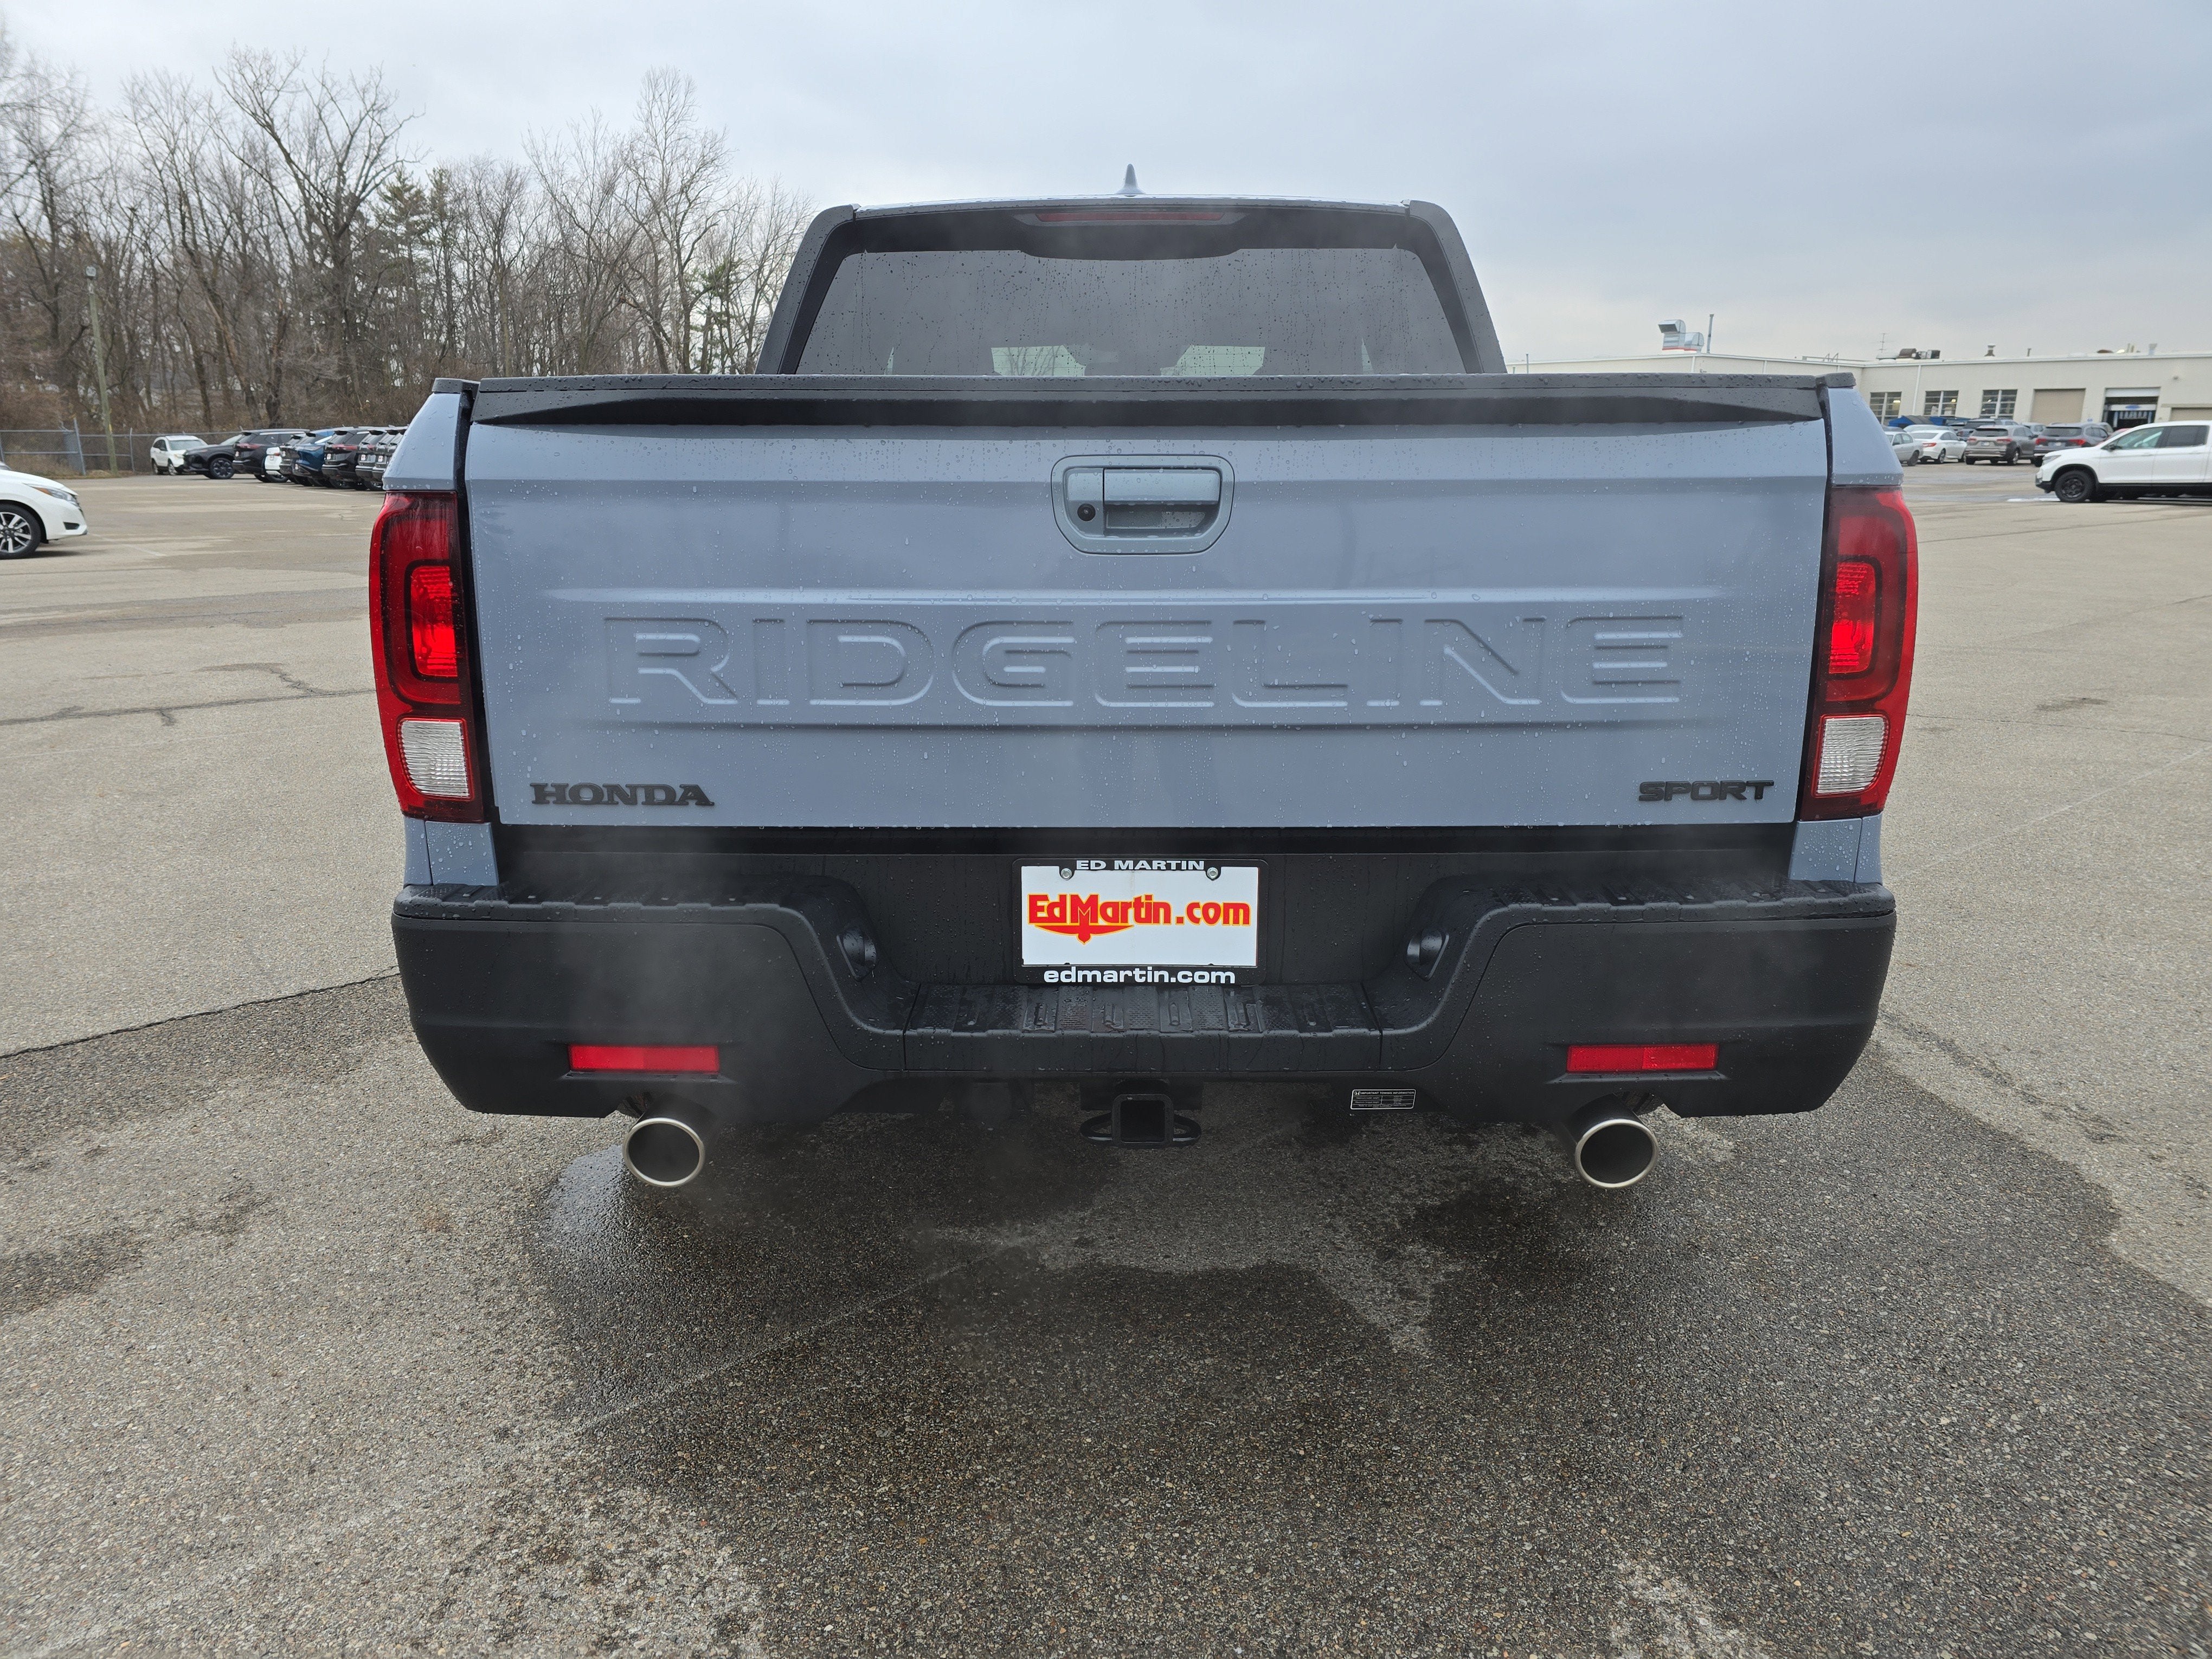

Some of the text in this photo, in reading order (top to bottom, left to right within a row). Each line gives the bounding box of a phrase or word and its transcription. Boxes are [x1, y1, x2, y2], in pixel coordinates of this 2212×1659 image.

[603, 617, 1684, 707] RIDGELINE
[530, 782, 715, 806] HONDA
[1638, 780, 1774, 801] SPORT
[1076, 860, 1205, 870] ED MARTIN
[1027, 893, 1251, 927] EdMartin.com
[1044, 966, 1236, 984] edmartin.com
